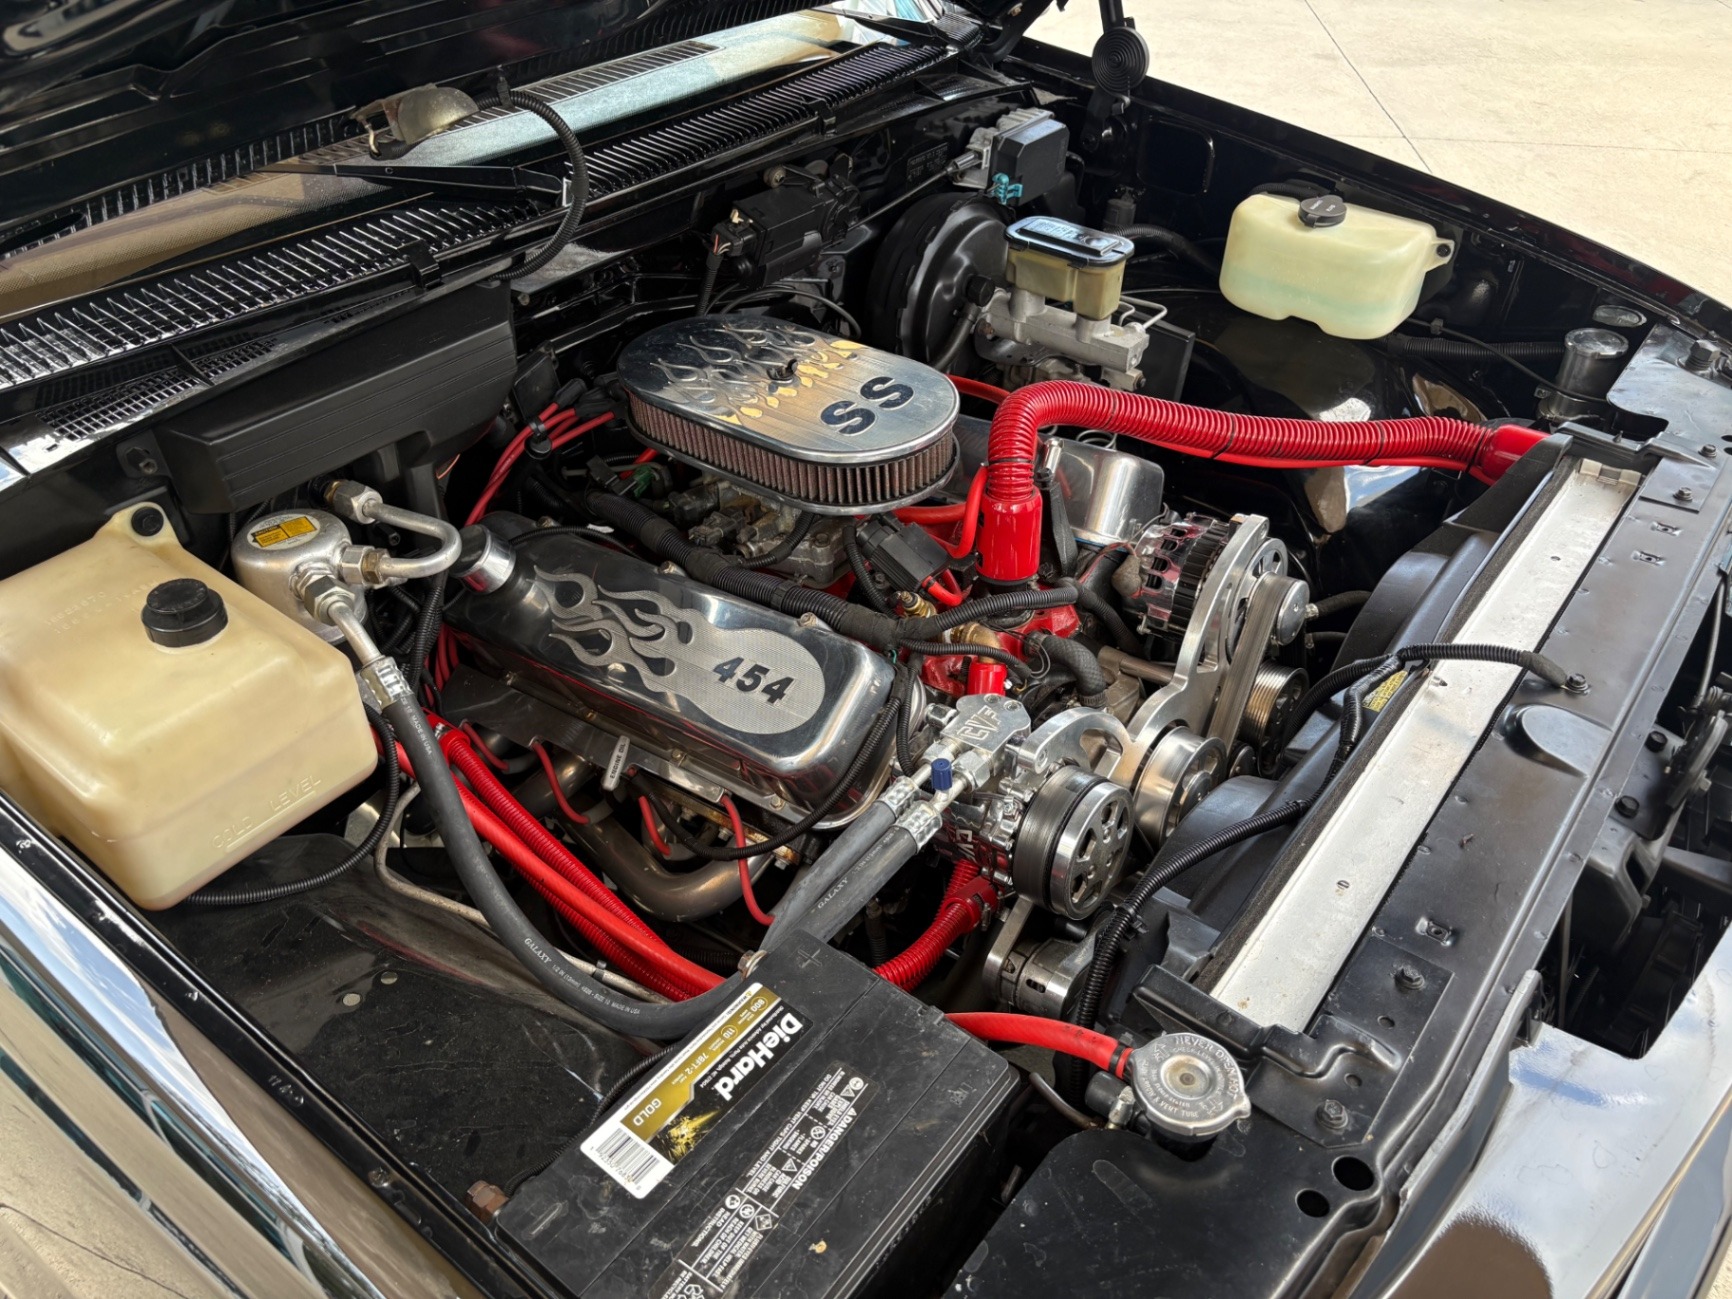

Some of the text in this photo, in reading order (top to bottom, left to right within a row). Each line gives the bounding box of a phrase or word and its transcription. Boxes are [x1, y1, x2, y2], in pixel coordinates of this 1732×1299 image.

[821, 376, 914, 436] SS
[713, 656, 795, 704] 454
[409, 714, 424, 733] MADE
[419, 732, 427, 741] IN
[423, 740, 433, 755] USA
[609, 742, 625, 779] ENGINE OIL
[209, 771, 322, 850] COLD LEVEL
[815, 876, 850, 909] GALAXY
[523, 936, 552, 965] GALAXY
[593, 992, 606, 1002] SIZE
[611, 1001, 624, 1010] MADE
[749, 997, 765, 1012] 800
[722, 1026, 735, 1039] 110
[1175, 1035, 1213, 1051] NEVER
[711, 1011, 804, 1101] DieHard
[815, 1080, 826, 1091] NOT
[823, 1073, 831, 1082] DO
[631, 1096, 662, 1127] GOLD
[799, 1097, 812, 1112] KEEP
[1159, 1099, 1178, 1113] VENT
[1181, 1110, 1198, 1118] TUBE
[789, 1110, 801, 1124] VENT
[779, 1122, 792, 1137] CAPS
[768, 1135, 782, 1151] TIGHT
[791, 1113, 853, 1190] DANGER/POISON
[759, 1149, 770, 1162] AND
[761, 1168, 781, 1192] CAN CAUSE
[751, 1186, 760, 1195] OR
[715, 1210, 730, 1227] READ
[723, 1216, 739, 1234] REACH
[712, 1219, 744, 1259] KEEP OUT OF THE
[719, 1231, 727, 1240] OF
[729, 1234, 747, 1255] MEDICAL
[721, 1253, 733, 1266] HELP
[673, 1271, 693, 1293] BATTERY
[679, 1269, 687, 1278] BE
